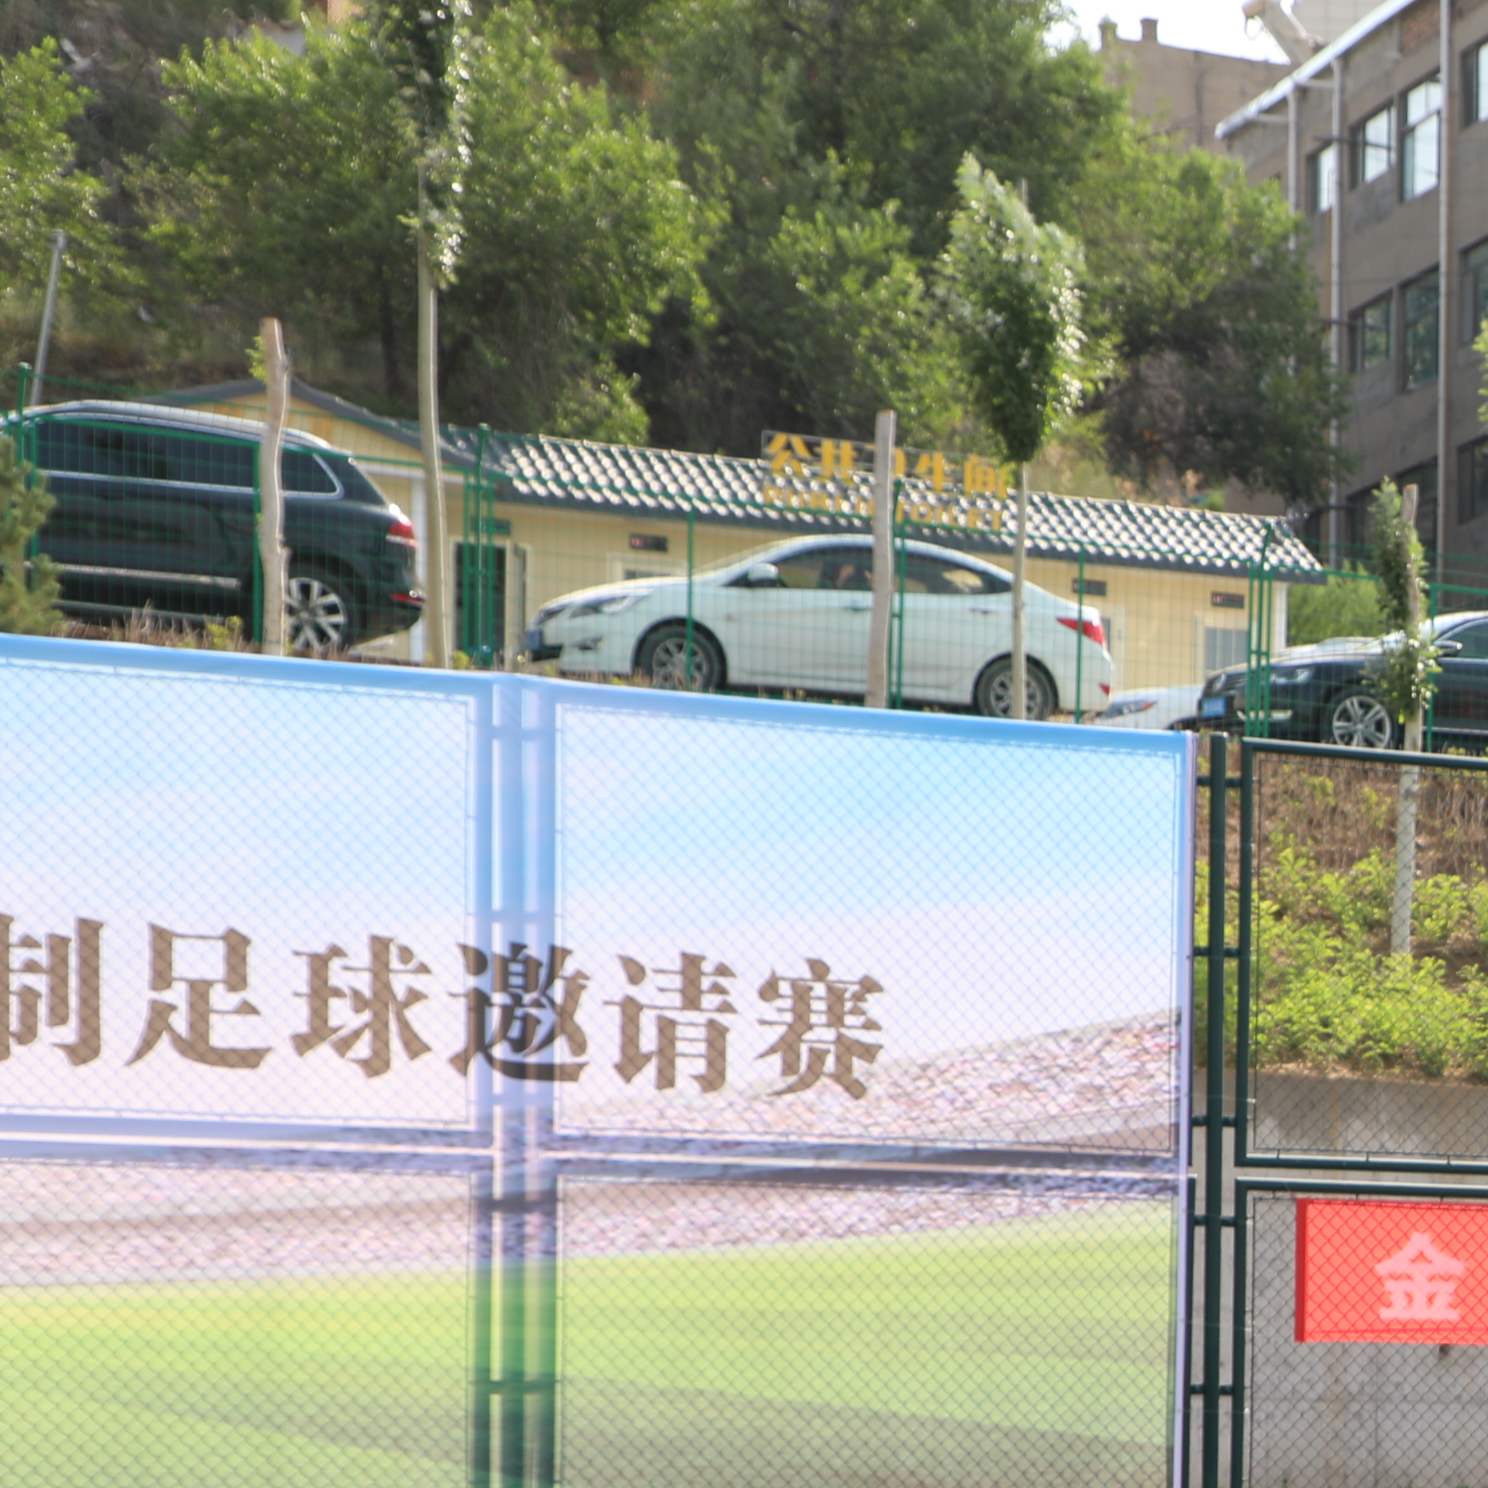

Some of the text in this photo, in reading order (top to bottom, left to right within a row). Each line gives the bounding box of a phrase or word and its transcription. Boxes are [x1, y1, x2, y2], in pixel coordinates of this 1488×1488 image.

[764, 432, 1007, 499] 公共生间
[0, 912, 886, 1101] 制足球邀请赛
